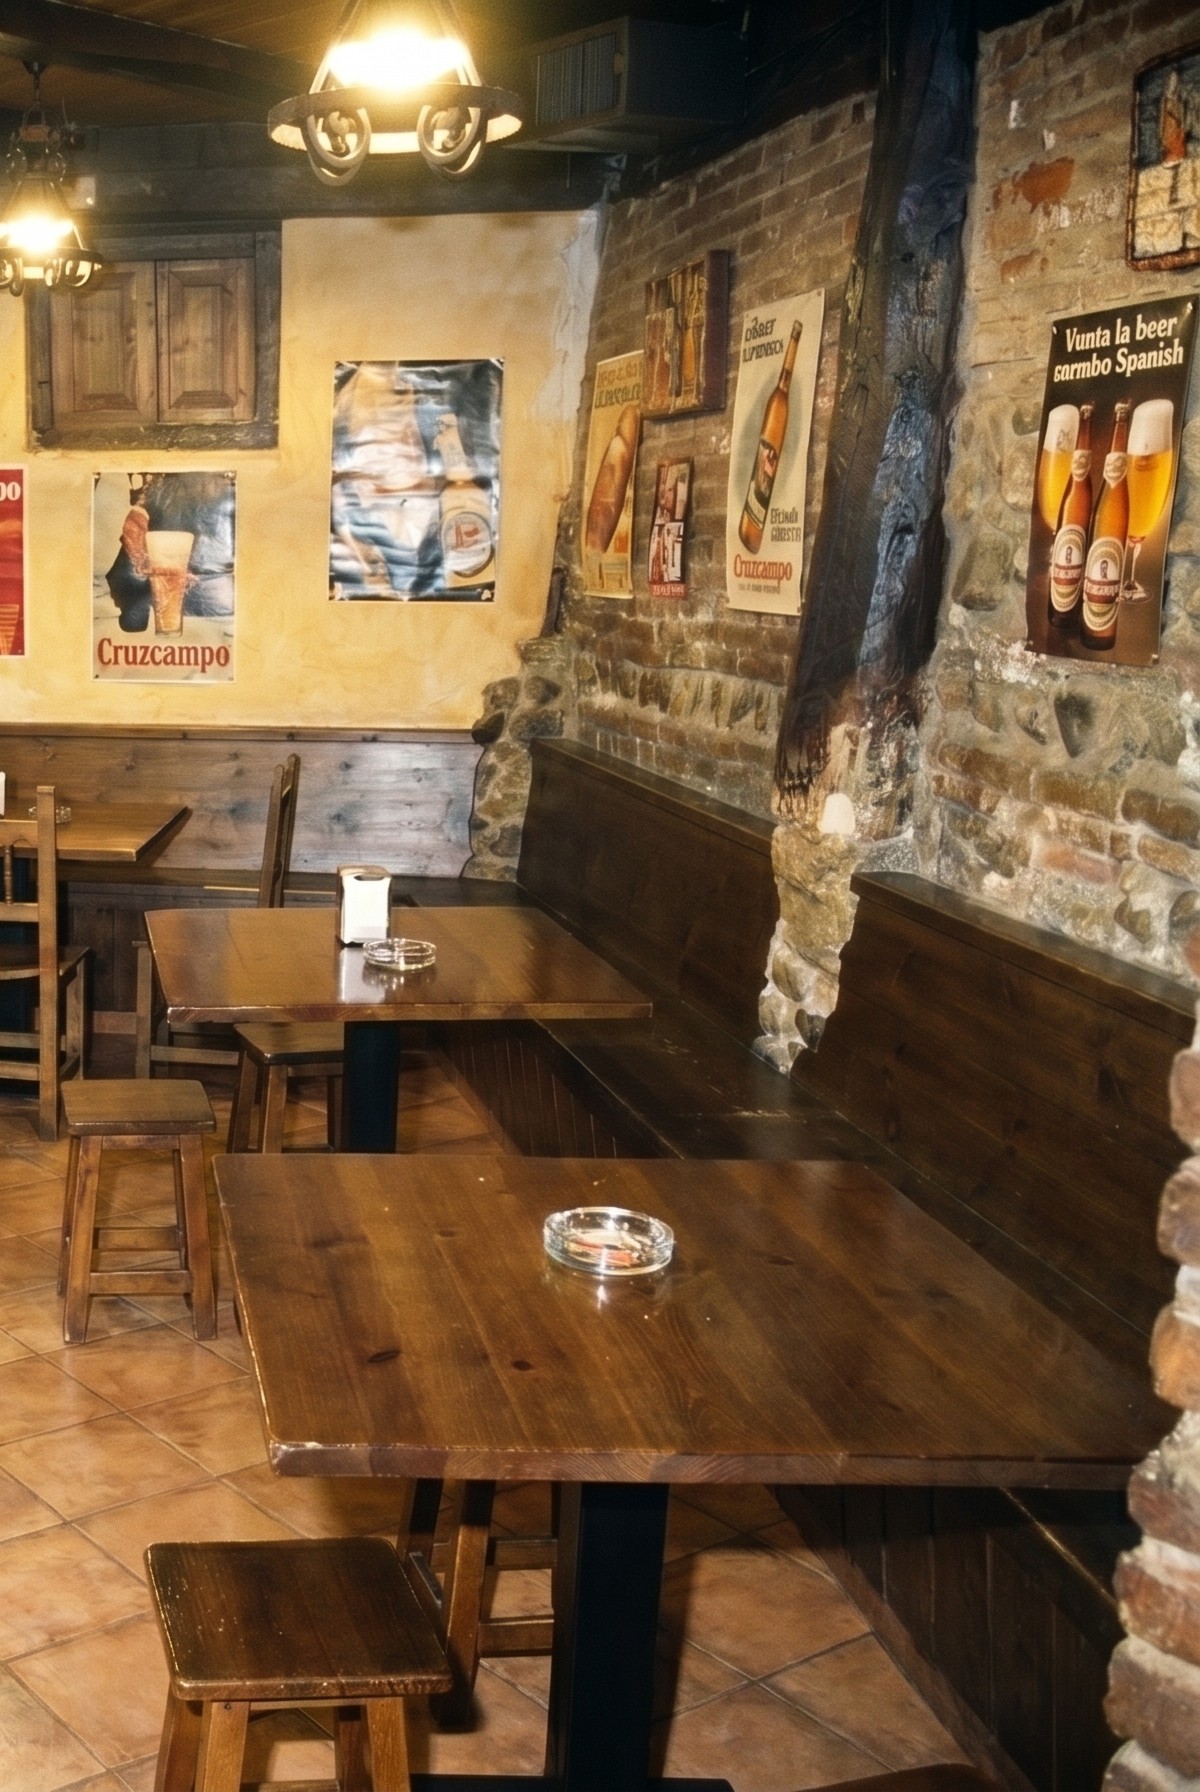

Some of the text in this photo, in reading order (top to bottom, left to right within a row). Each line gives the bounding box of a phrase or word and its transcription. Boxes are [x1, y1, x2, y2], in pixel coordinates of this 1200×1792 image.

[1065, 313, 1177, 352] Vunta la beer
[1115, 338, 1183, 377] Spanish
[734, 553, 793, 586] Cruzcampo
[97, 638, 230, 673] Cruzcampo
